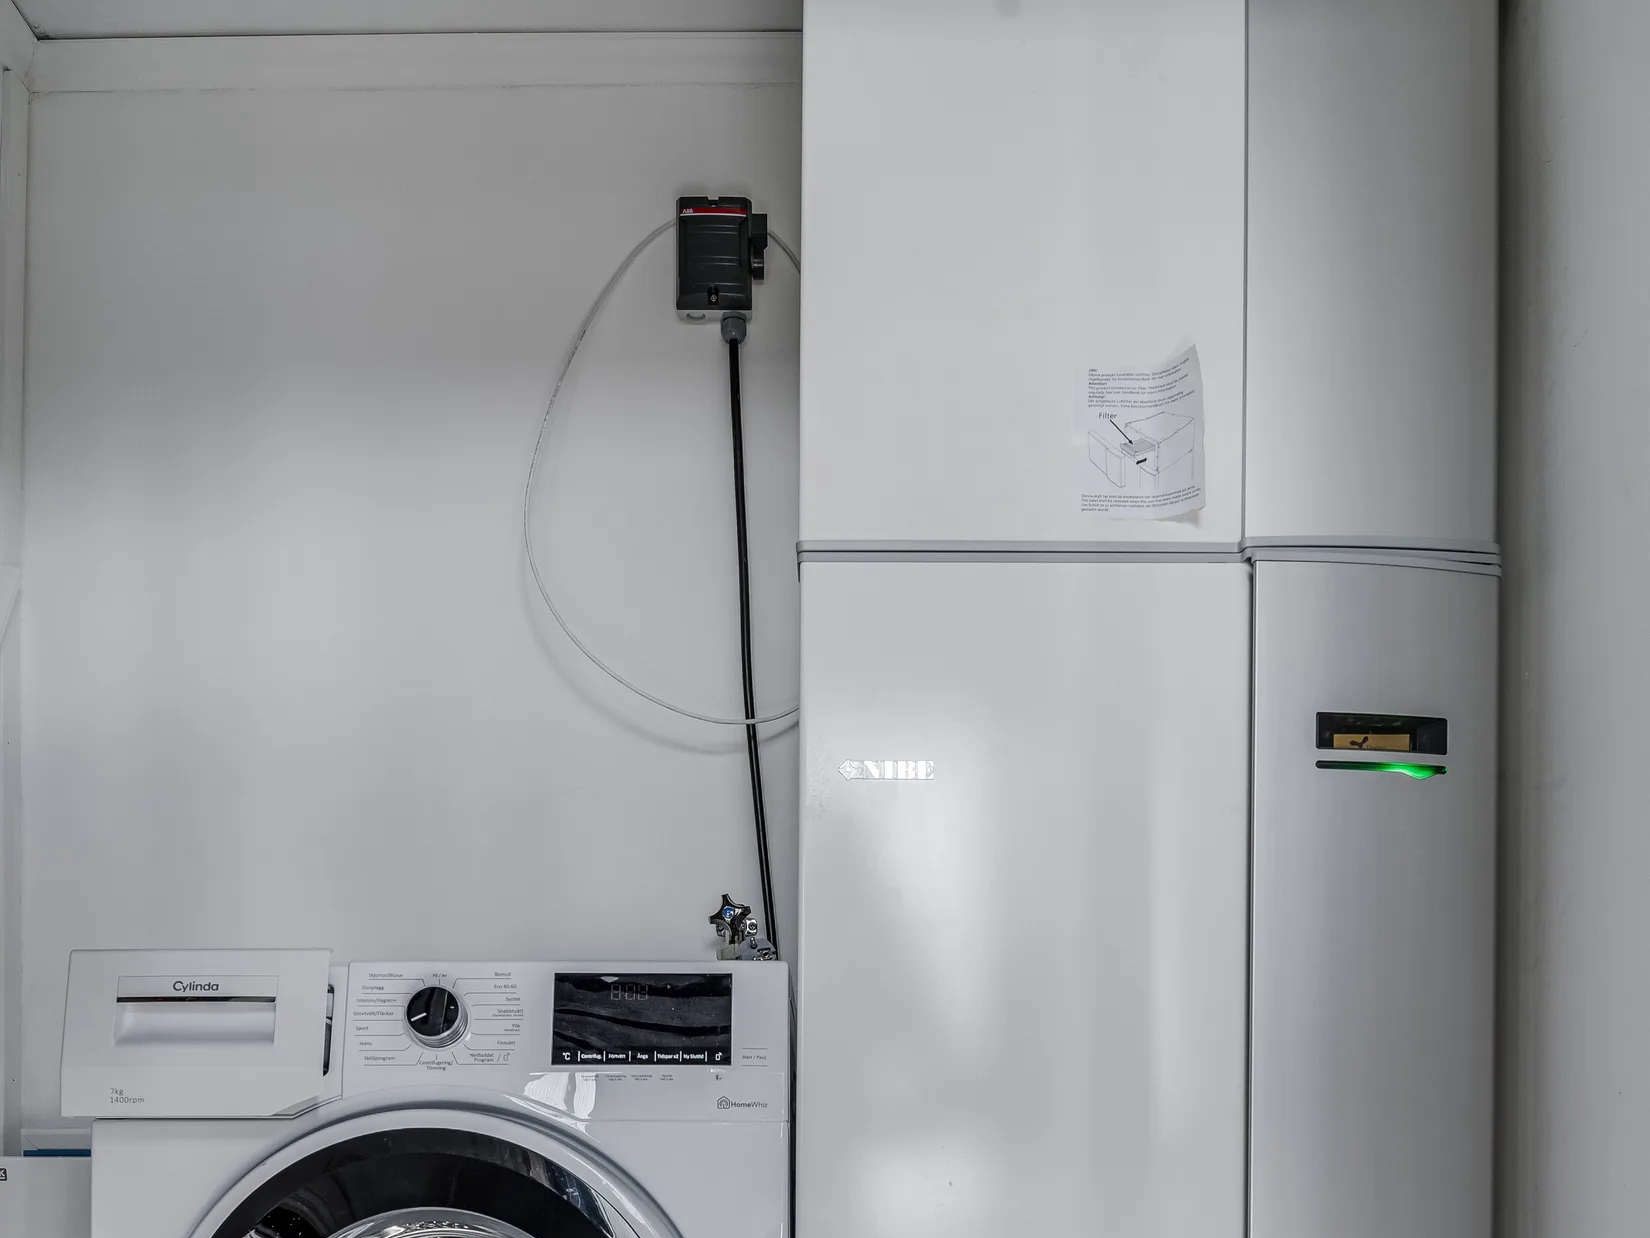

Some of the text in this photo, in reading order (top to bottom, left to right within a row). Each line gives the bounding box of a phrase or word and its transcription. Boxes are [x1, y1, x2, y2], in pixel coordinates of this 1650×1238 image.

[1098, 412, 1118, 420] Filter
[859, 759, 934, 780] NIBE
[172, 980, 220, 994] Cylinda
[362, 984, 385, 992] Dunplagg
[364, 1054, 396, 1062] Sköljprogram
[637, 1052, 649, 1061] Ånga
[109, 1087, 124, 1097] 7kg
[109, 1096, 145, 1105] 1400rpm
[731, 1100, 768, 1109] HomeWhiz
